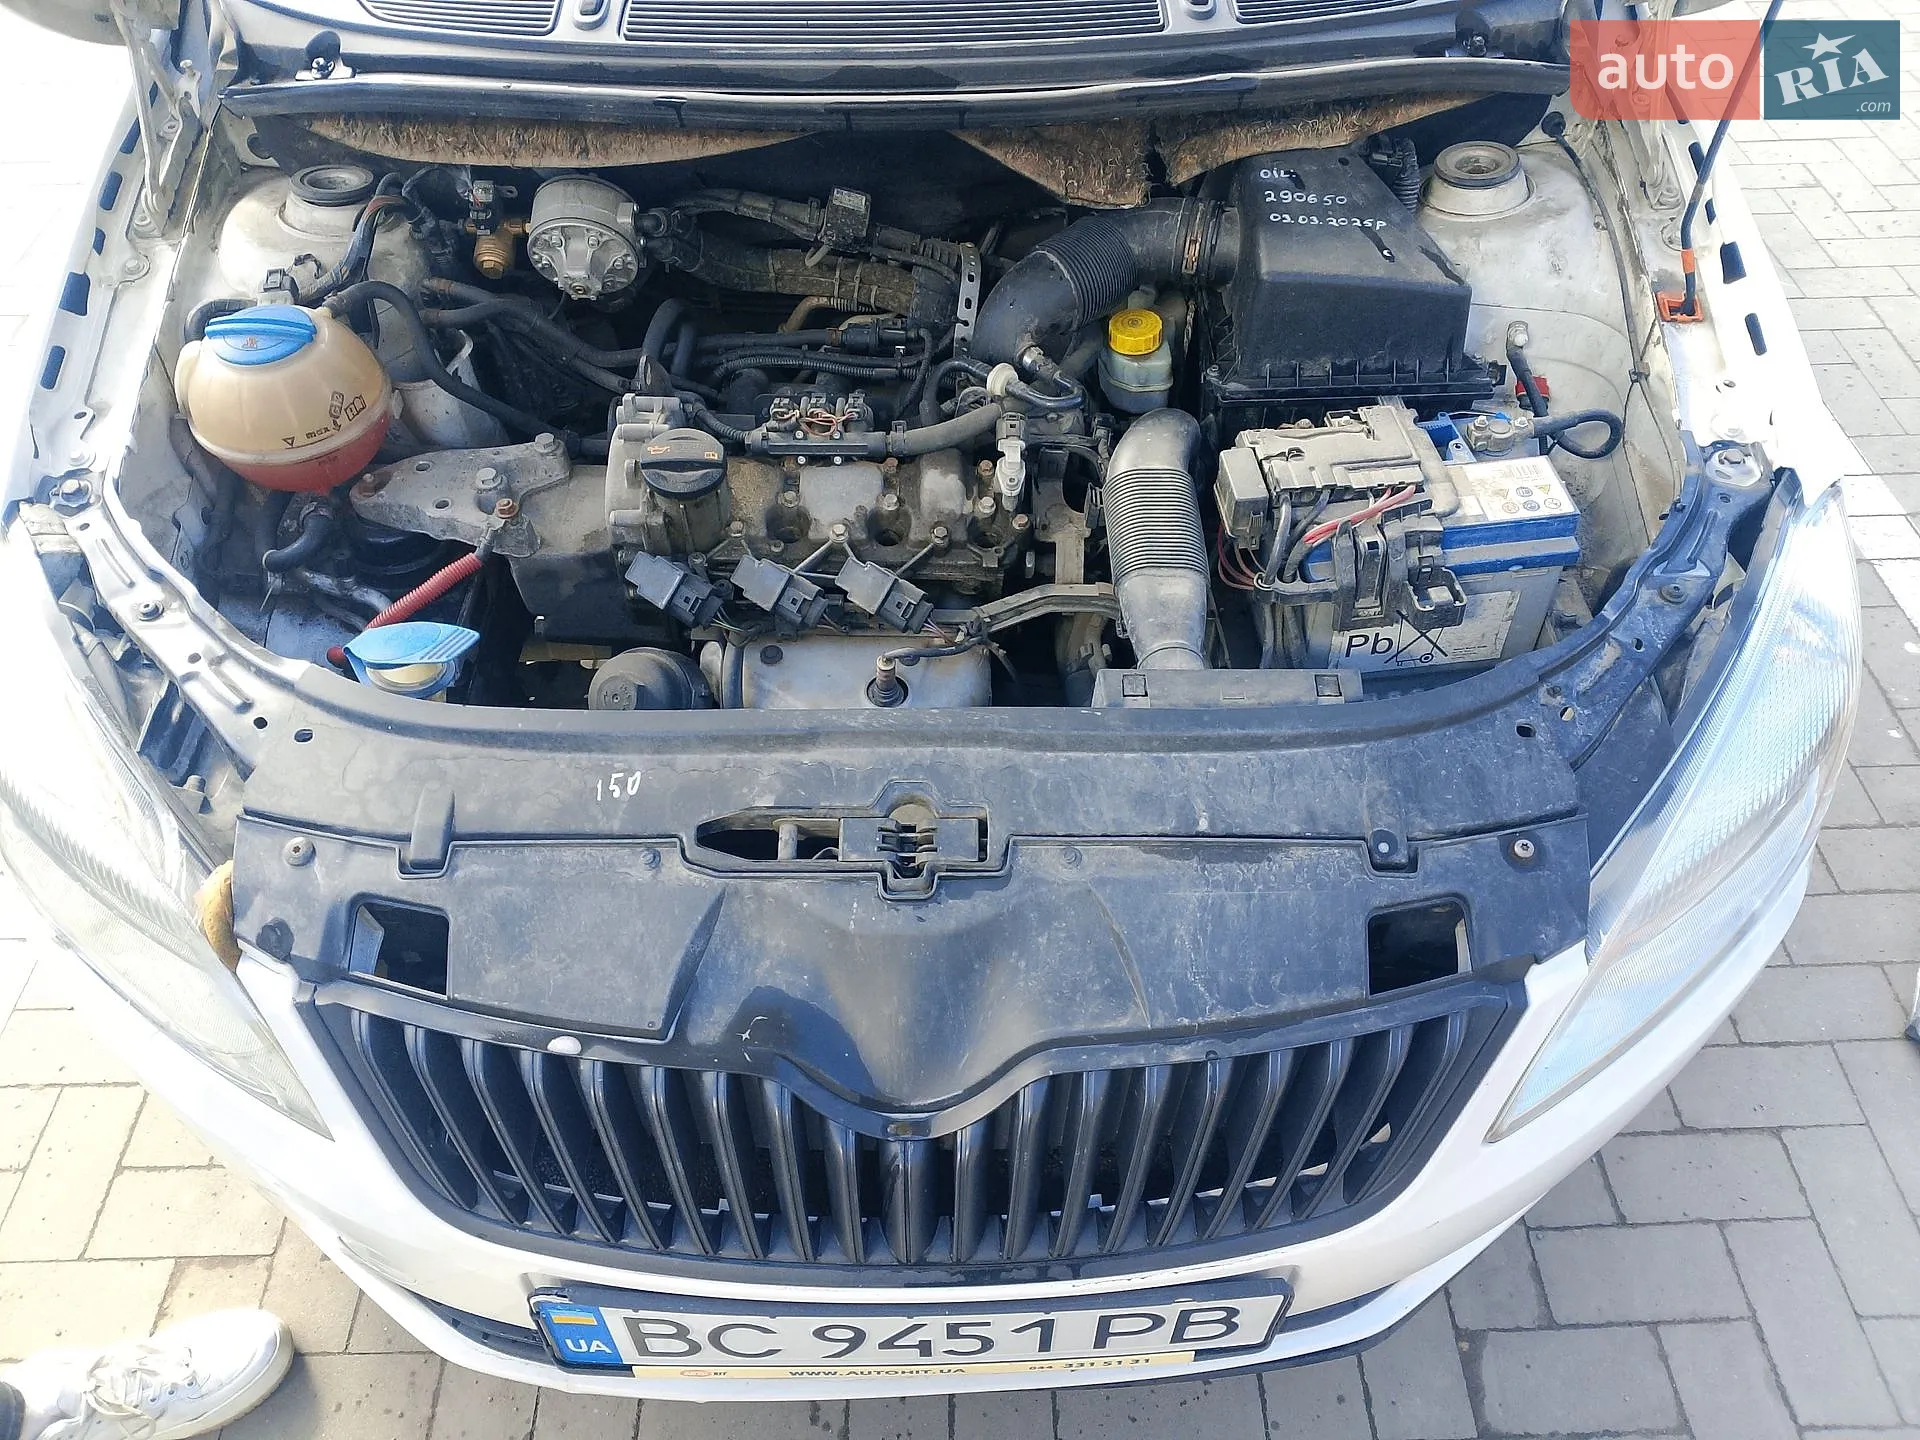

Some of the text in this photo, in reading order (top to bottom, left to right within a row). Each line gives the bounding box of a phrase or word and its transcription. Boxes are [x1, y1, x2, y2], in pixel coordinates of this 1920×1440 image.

[1345, 632, 1394, 657] Pb
[597, 771, 641, 801] 150
[564, 1338, 613, 1354] UA
[622, 1306, 1241, 1359] BC 9451 PB
